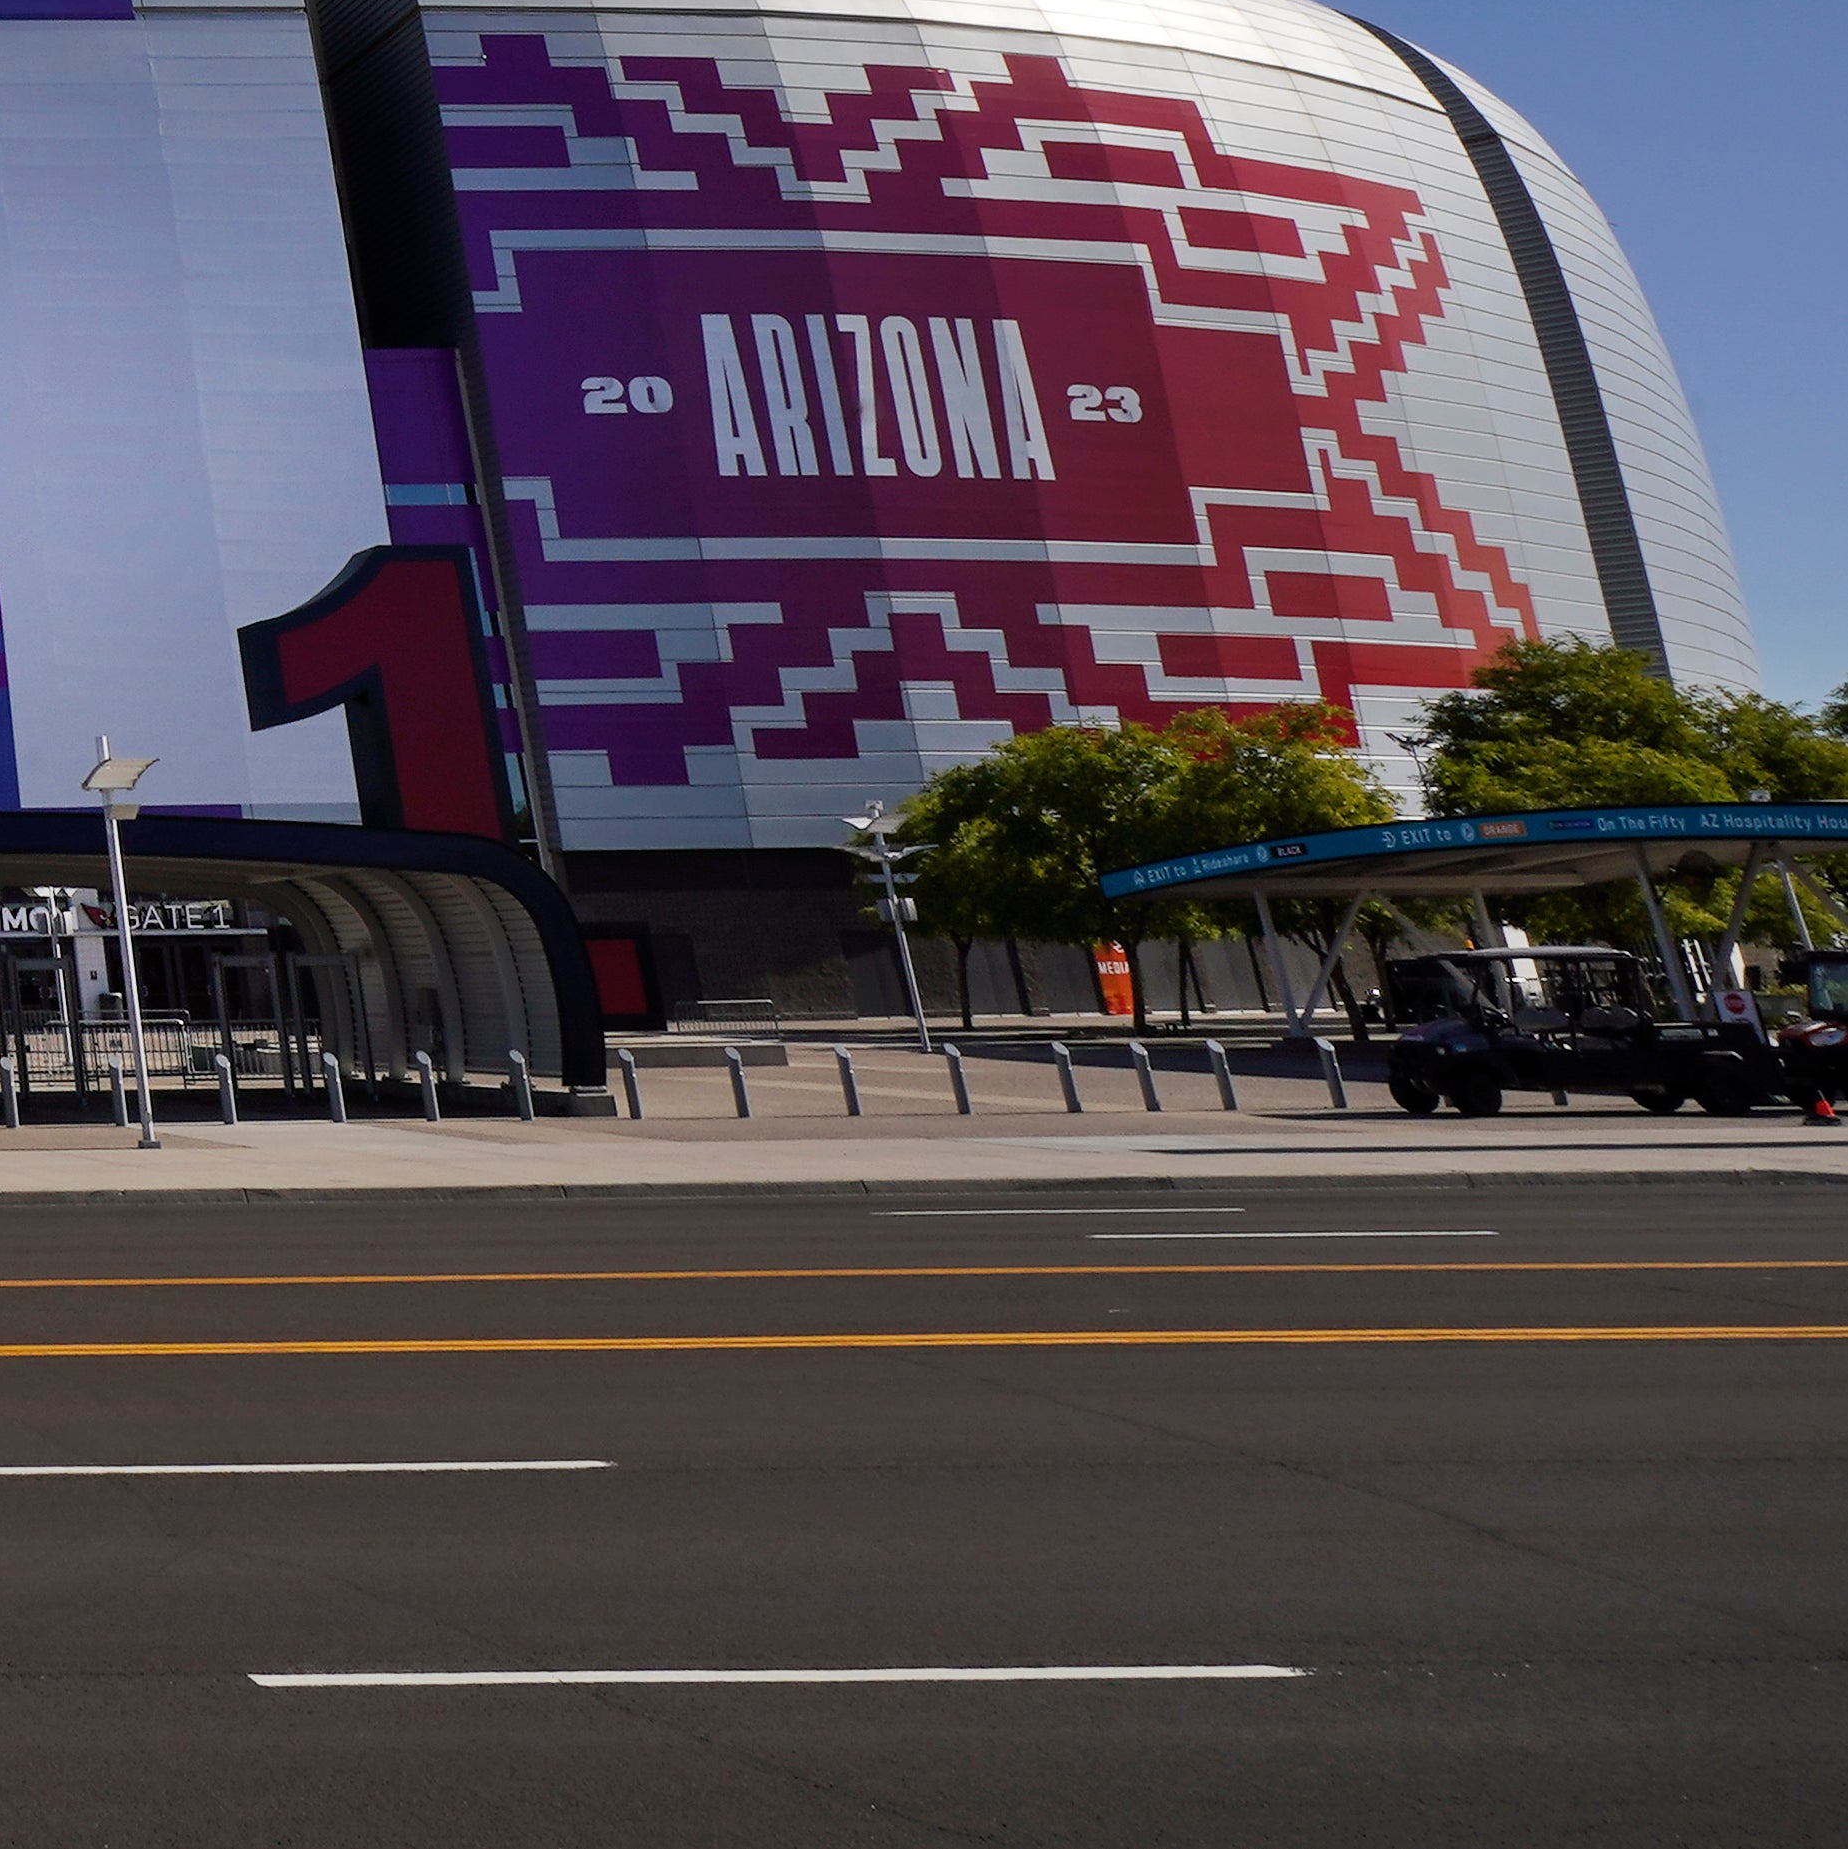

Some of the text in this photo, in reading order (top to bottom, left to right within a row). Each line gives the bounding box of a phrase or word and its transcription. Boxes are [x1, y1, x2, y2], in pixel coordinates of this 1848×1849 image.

[581, 313, 1142, 481] 20 ARIZONA 23
[237, 545, 515, 842] 1
[1597, 816, 1616, 831] On
[1618, 815, 1646, 830] The
[1648, 814, 1685, 832] Fifty
[1700, 813, 1719, 828] AZ
[1723, 813, 1812, 832] Hospitality
[1401, 828, 1431, 846] EXIT
[1436, 828, 1453, 842] to
[1147, 865, 1170, 883] EXIT
[1174, 865, 1187, 878] to
[212, 904, 231, 929] 1
